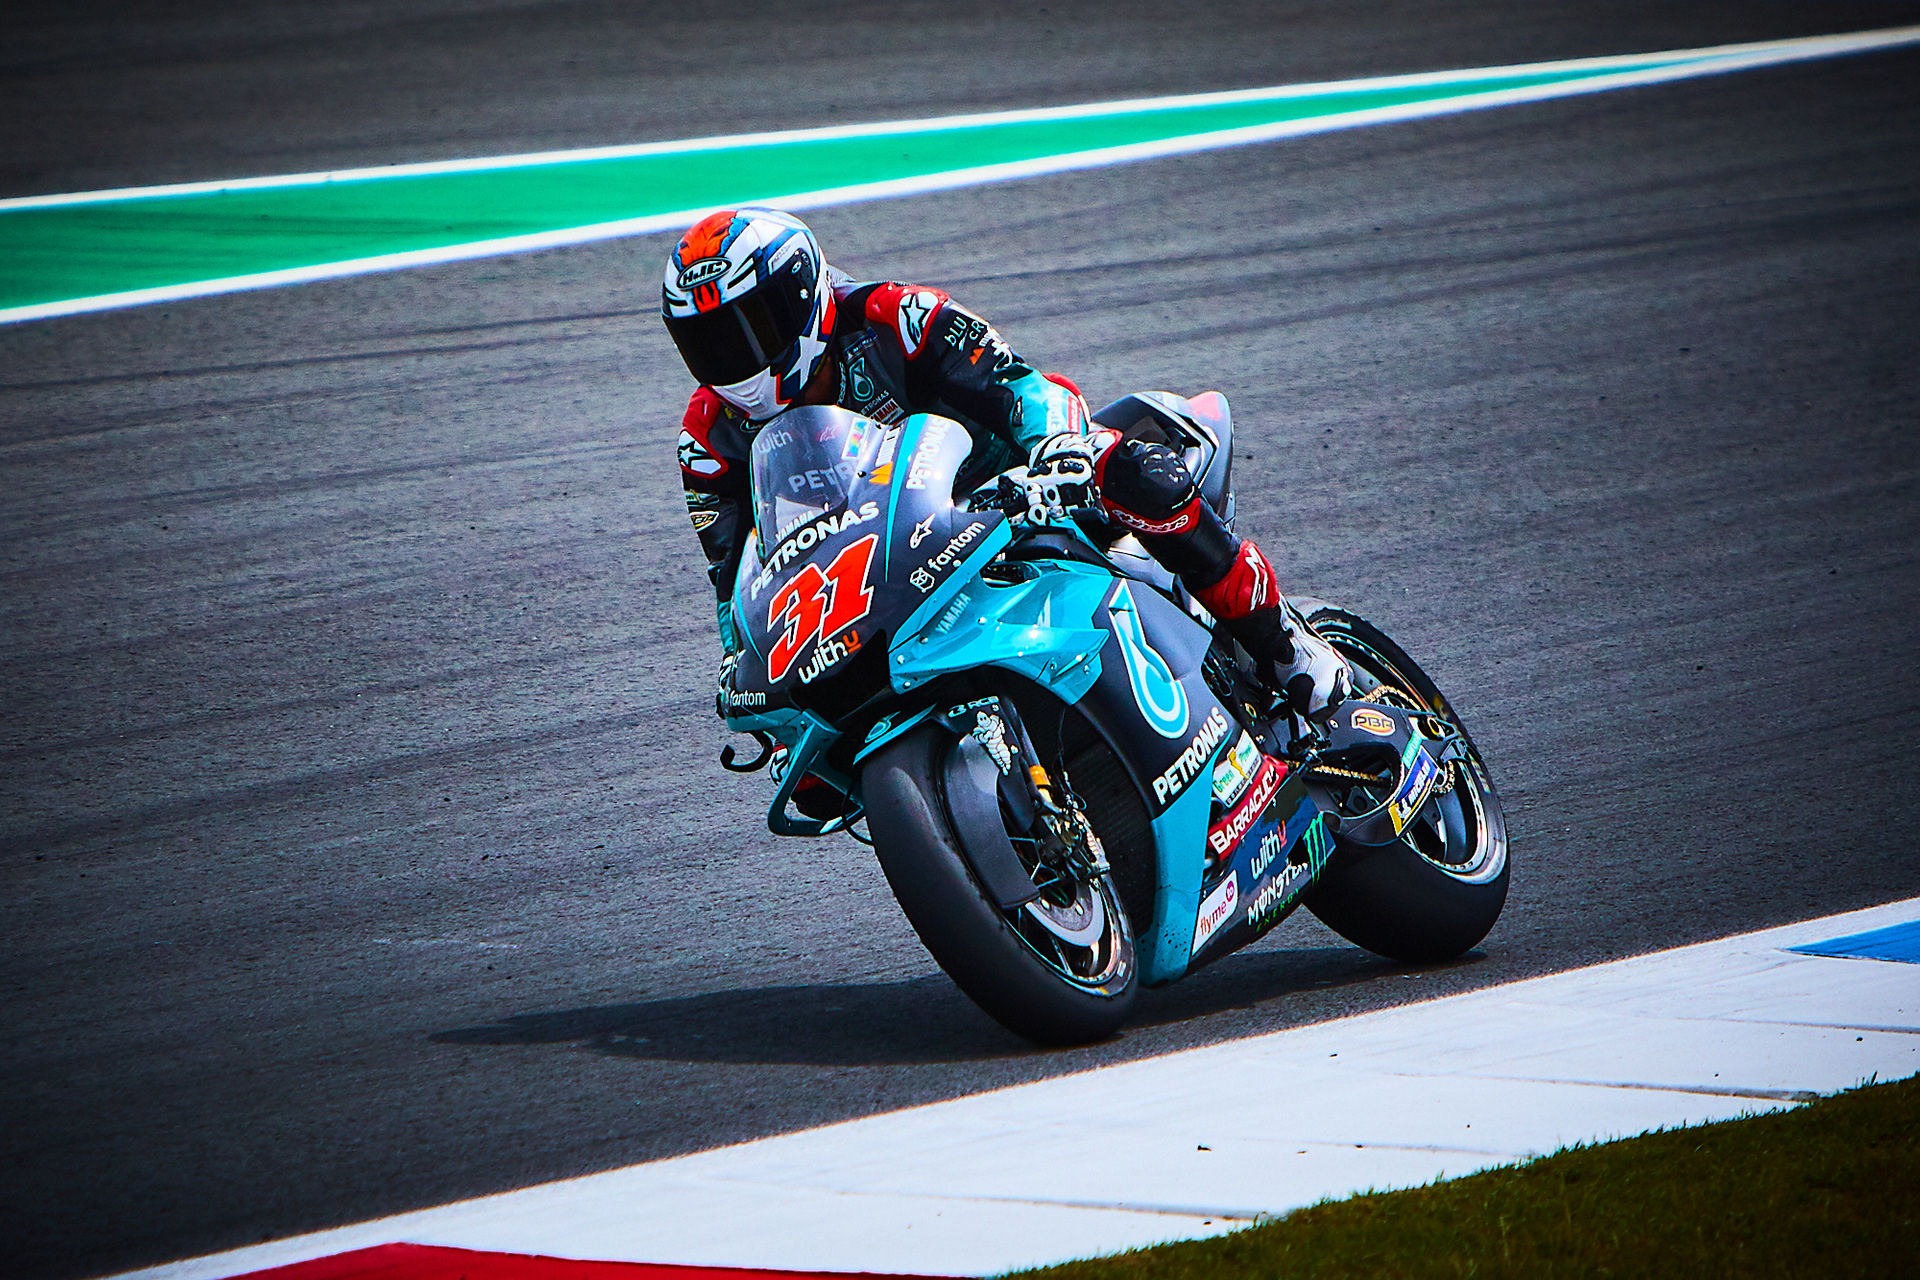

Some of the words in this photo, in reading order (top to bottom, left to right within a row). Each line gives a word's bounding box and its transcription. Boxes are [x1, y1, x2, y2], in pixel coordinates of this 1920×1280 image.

[682, 260, 724, 287] HJC
[860, 389, 890, 416] ETRONAS
[906, 417, 951, 490] PETRONAS
[776, 510, 816, 541] YAMAHA
[928, 521, 986, 573] fantom
[751, 501, 880, 601] PETRONAS
[766, 533, 880, 685] 31
[935, 592, 972, 635] YAMAHA
[730, 690, 766, 707] fantom
[1152, 706, 1228, 796] PETRONAS
[1200, 900, 1227, 937] flyme
